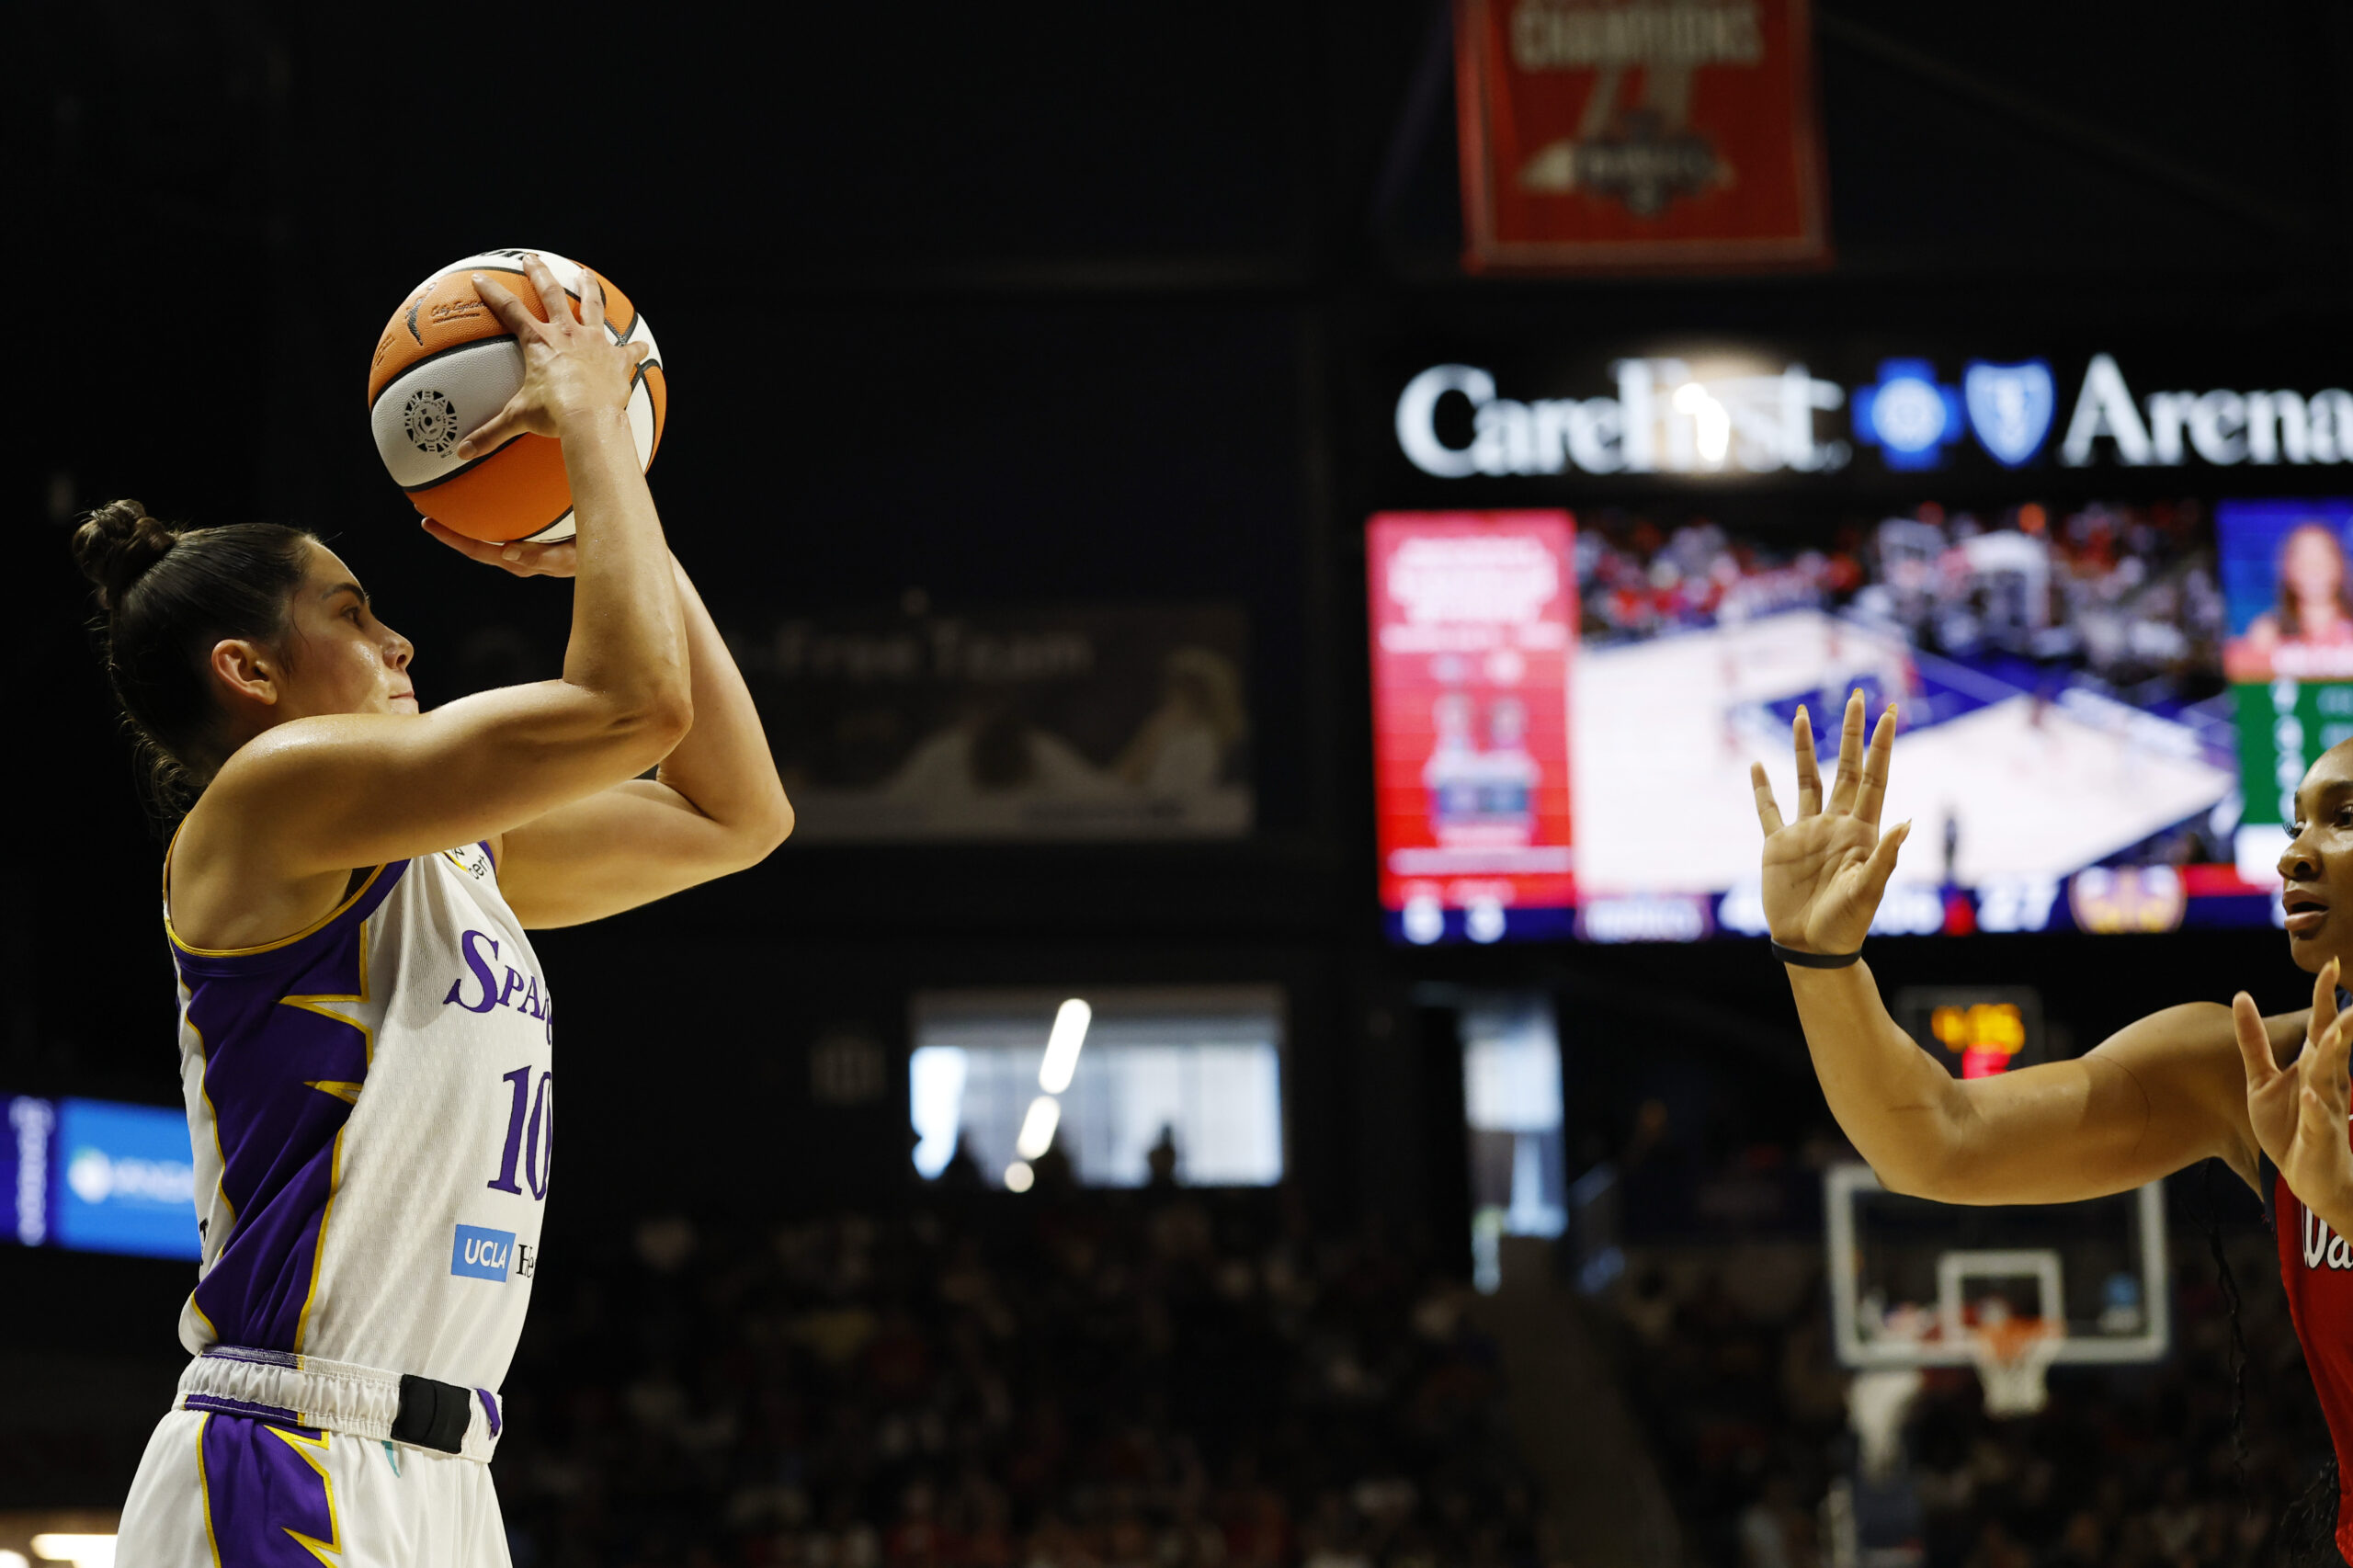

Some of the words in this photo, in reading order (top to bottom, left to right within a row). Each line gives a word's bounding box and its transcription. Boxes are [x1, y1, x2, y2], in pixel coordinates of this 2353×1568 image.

[2059, 353, 2353, 465] Arena
[487, 1065, 551, 1200] 10
[464, 1238, 506, 1269] UCLA
